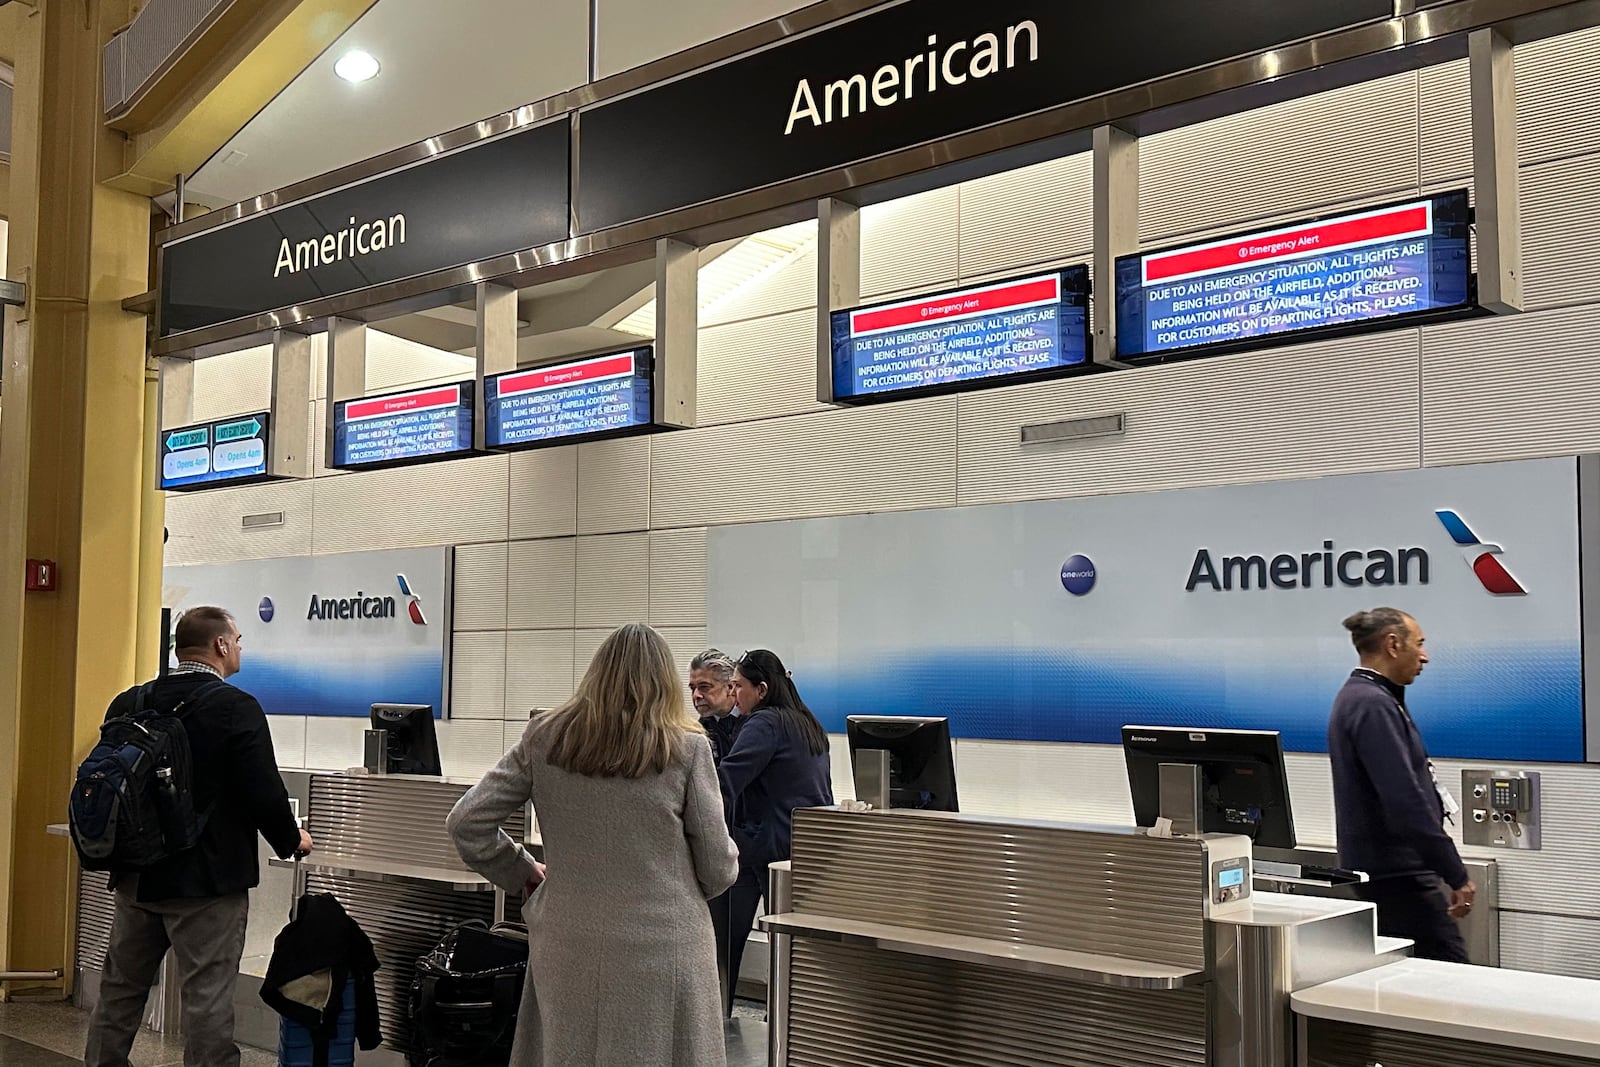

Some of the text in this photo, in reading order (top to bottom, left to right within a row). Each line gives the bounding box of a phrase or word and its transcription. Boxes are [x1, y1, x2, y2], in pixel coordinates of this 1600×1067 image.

[784, 19, 1038, 135] American
[273, 213, 406, 278] American
[1249, 235, 1319, 255] Emergency Alert
[1150, 243, 1424, 301] DUE TO AN EMERGENCY SITUATION, ALL FLIGHTS ARE
[1173, 265, 1396, 312] BEING HELD ON THE AIRFIELD, ADDITIONAL
[929, 300, 979, 315] Emergency Alert
[1152, 277, 1422, 330] INFORMATION WILL BE AVAILABLE AS IT IS RECEIVED.
[1158, 331, 1177, 343] FOR
[1179, 322, 1239, 341] CUSTOMERS
[1242, 318, 1258, 330] ON
[1261, 309, 1321, 328] DEPARTING
[1324, 302, 1371, 319] FLIGHTS,
[1374, 293, 1416, 309] PLEASE
[857, 309, 1055, 351] DUE TO AN EMERGENCY SITUATION, ALL FLIGHTS ARE
[874, 327, 1035, 361] BEING HELD ON THE AIRFIELD, ADDITIONAL
[859, 338, 1053, 376] INFORMATION WILL BE AVAILABLE AS IT IS RECEIVED.
[863, 377, 877, 388] FOR
[879, 371, 923, 387] CUSTOMERS
[924, 368, 936, 379] ON
[938, 362, 982, 378] DEPARTING
[983, 357, 1017, 371] FLIGHTS,
[1019, 352, 1049, 365] PLEASE
[501, 401, 512, 409] DUE
[528, 394, 558, 405] EMERGENCY
[598, 383, 619, 393] FLIGHTS
[620, 380, 631, 388] ARE
[513, 409, 527, 417] BEING
[529, 407, 541, 415] HELD
[586, 395, 618, 406] ADDITIONAL
[503, 418, 536, 429] INFORMATION
[537, 415, 549, 424] WILL
[557, 410, 584, 421] AVAILABLE
[506, 430, 515, 439] FOR
[516, 427, 546, 437] CUSTOMERS
[546, 424, 554, 432] ON
[556, 421, 584, 432] DEPARTING
[608, 414, 627, 423] PLEASE
[1062, 570, 1094, 578] oneworld
[1185, 540, 1430, 593] American
[307, 591, 396, 620] American
